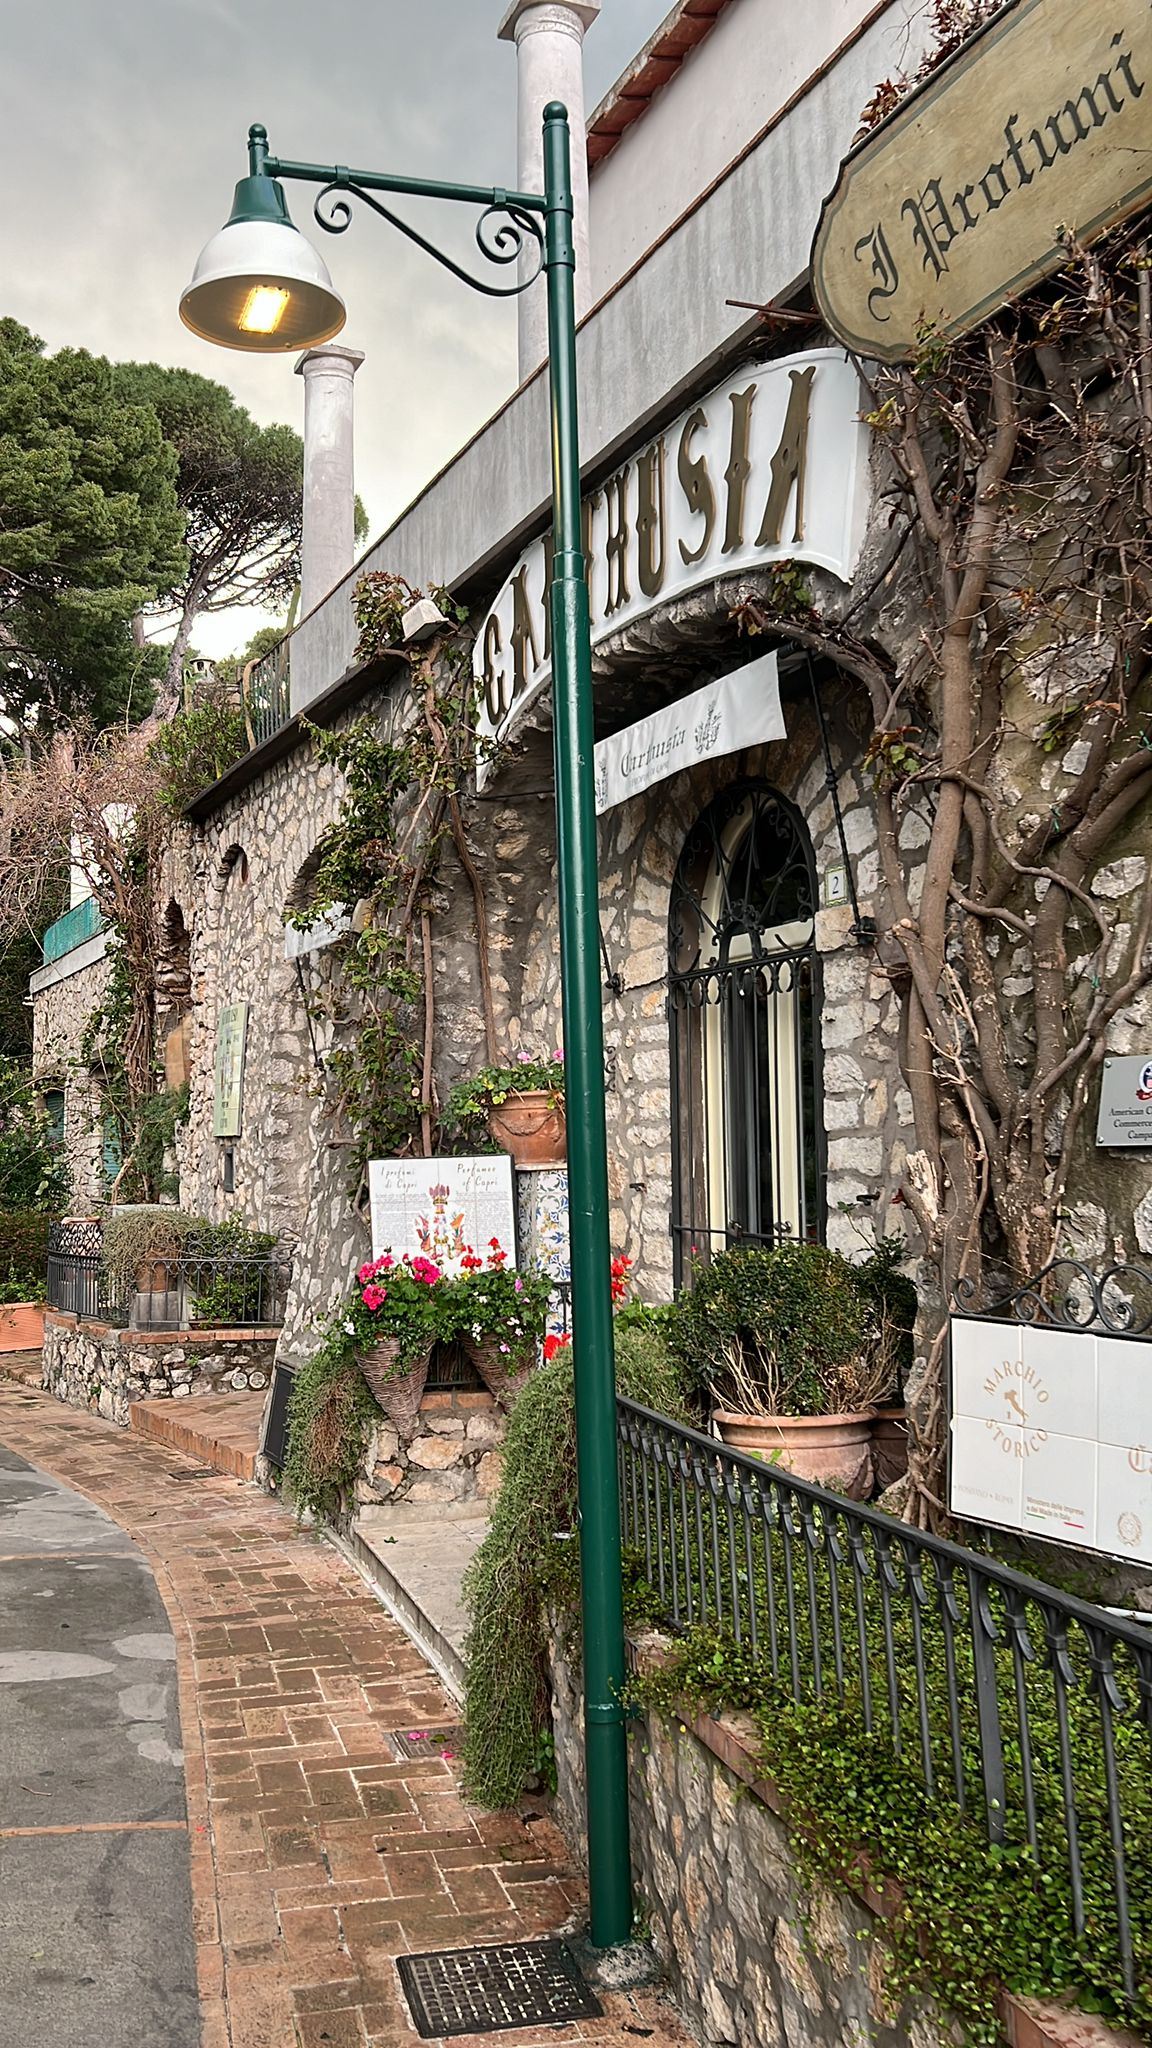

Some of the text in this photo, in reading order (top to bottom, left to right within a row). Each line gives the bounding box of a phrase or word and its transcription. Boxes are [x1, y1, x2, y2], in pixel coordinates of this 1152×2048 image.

[900, 28, 1146, 283] Profumi
[484, 365, 817, 728] CATHUSIA
[832, 876, 839, 894] 2
[1108, 1106, 1144, 1116] American
[475, 1175, 499, 1191] Capri
[983, 1360, 1049, 1403] MARCHIO
[985, 1419, 1049, 1458] STORICO
